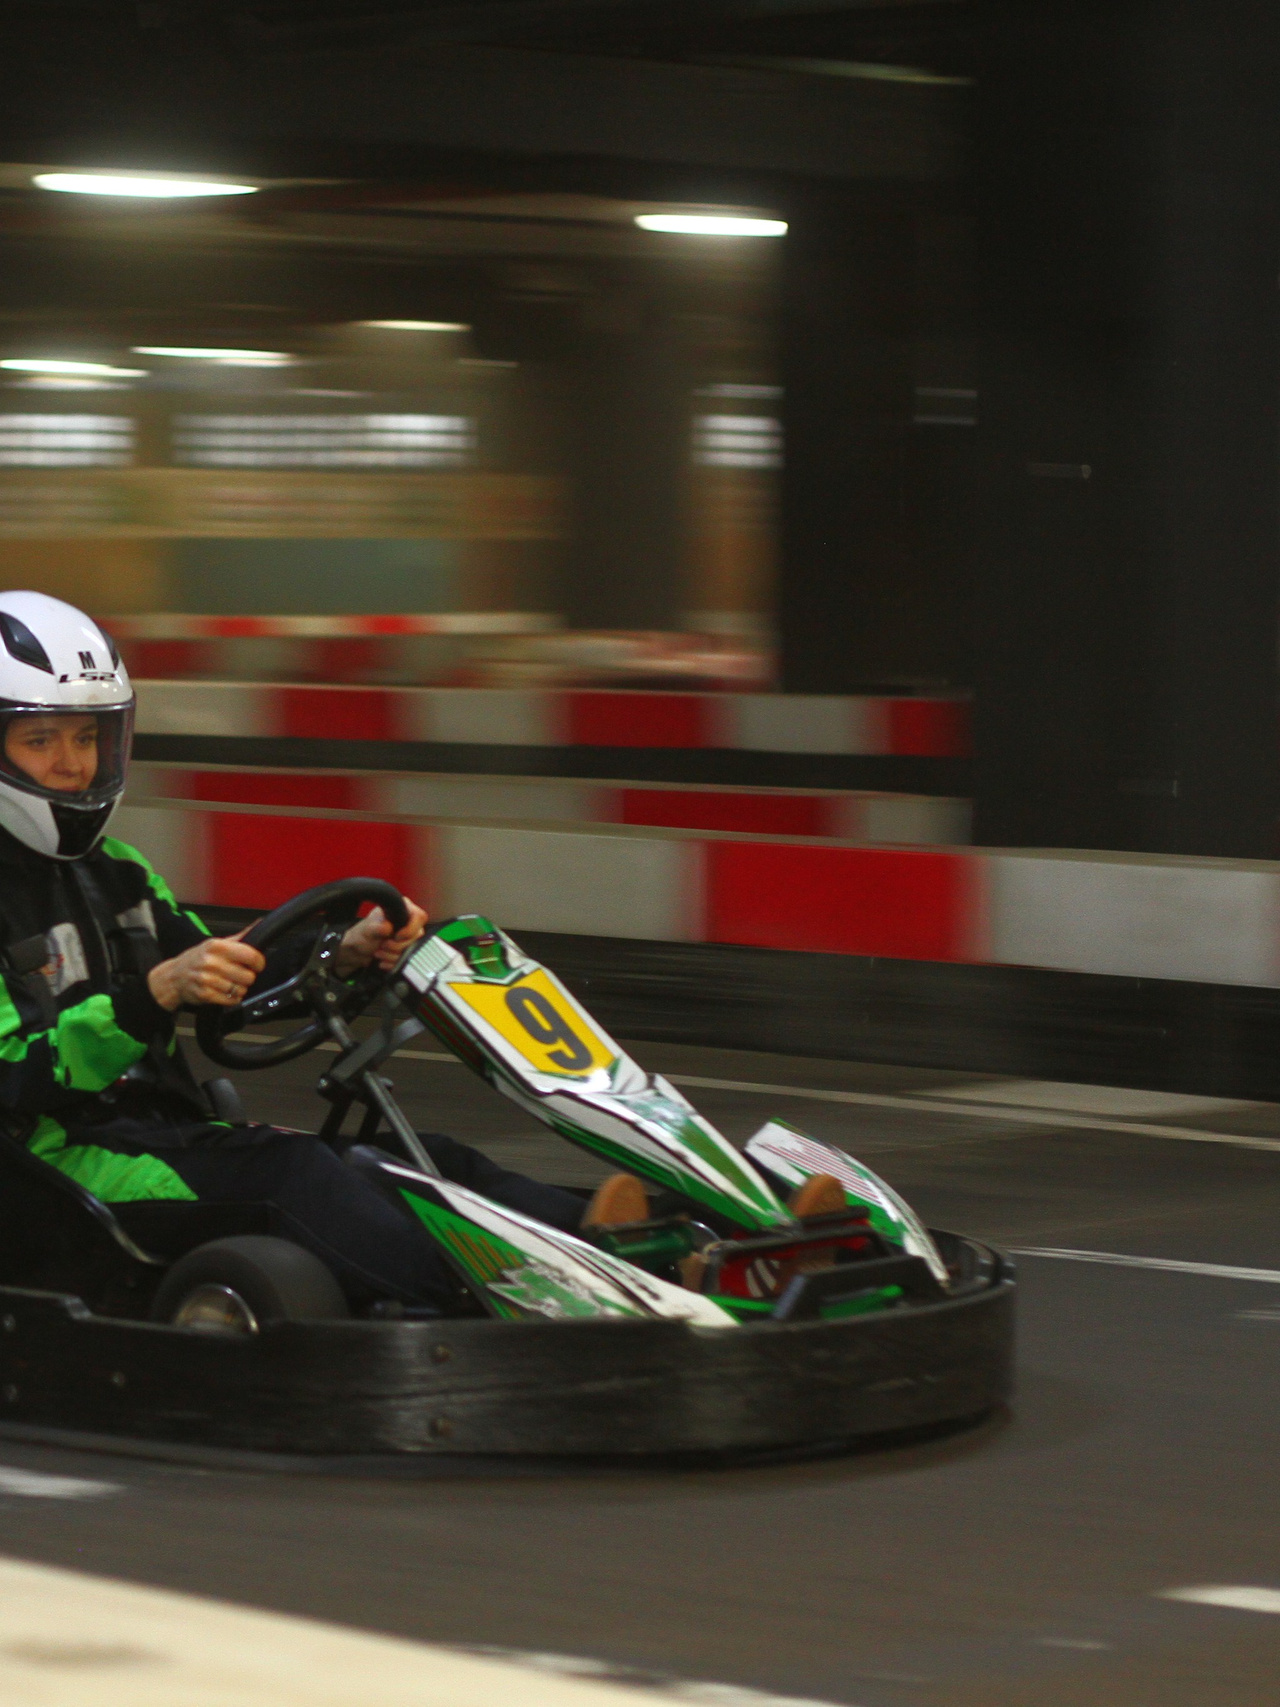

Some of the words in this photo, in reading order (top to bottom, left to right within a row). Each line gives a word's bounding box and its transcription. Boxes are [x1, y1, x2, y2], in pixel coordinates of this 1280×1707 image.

[78, 651, 96, 669] M
[59, 672, 115, 684] LS2
[504, 986, 593, 1071] 9
